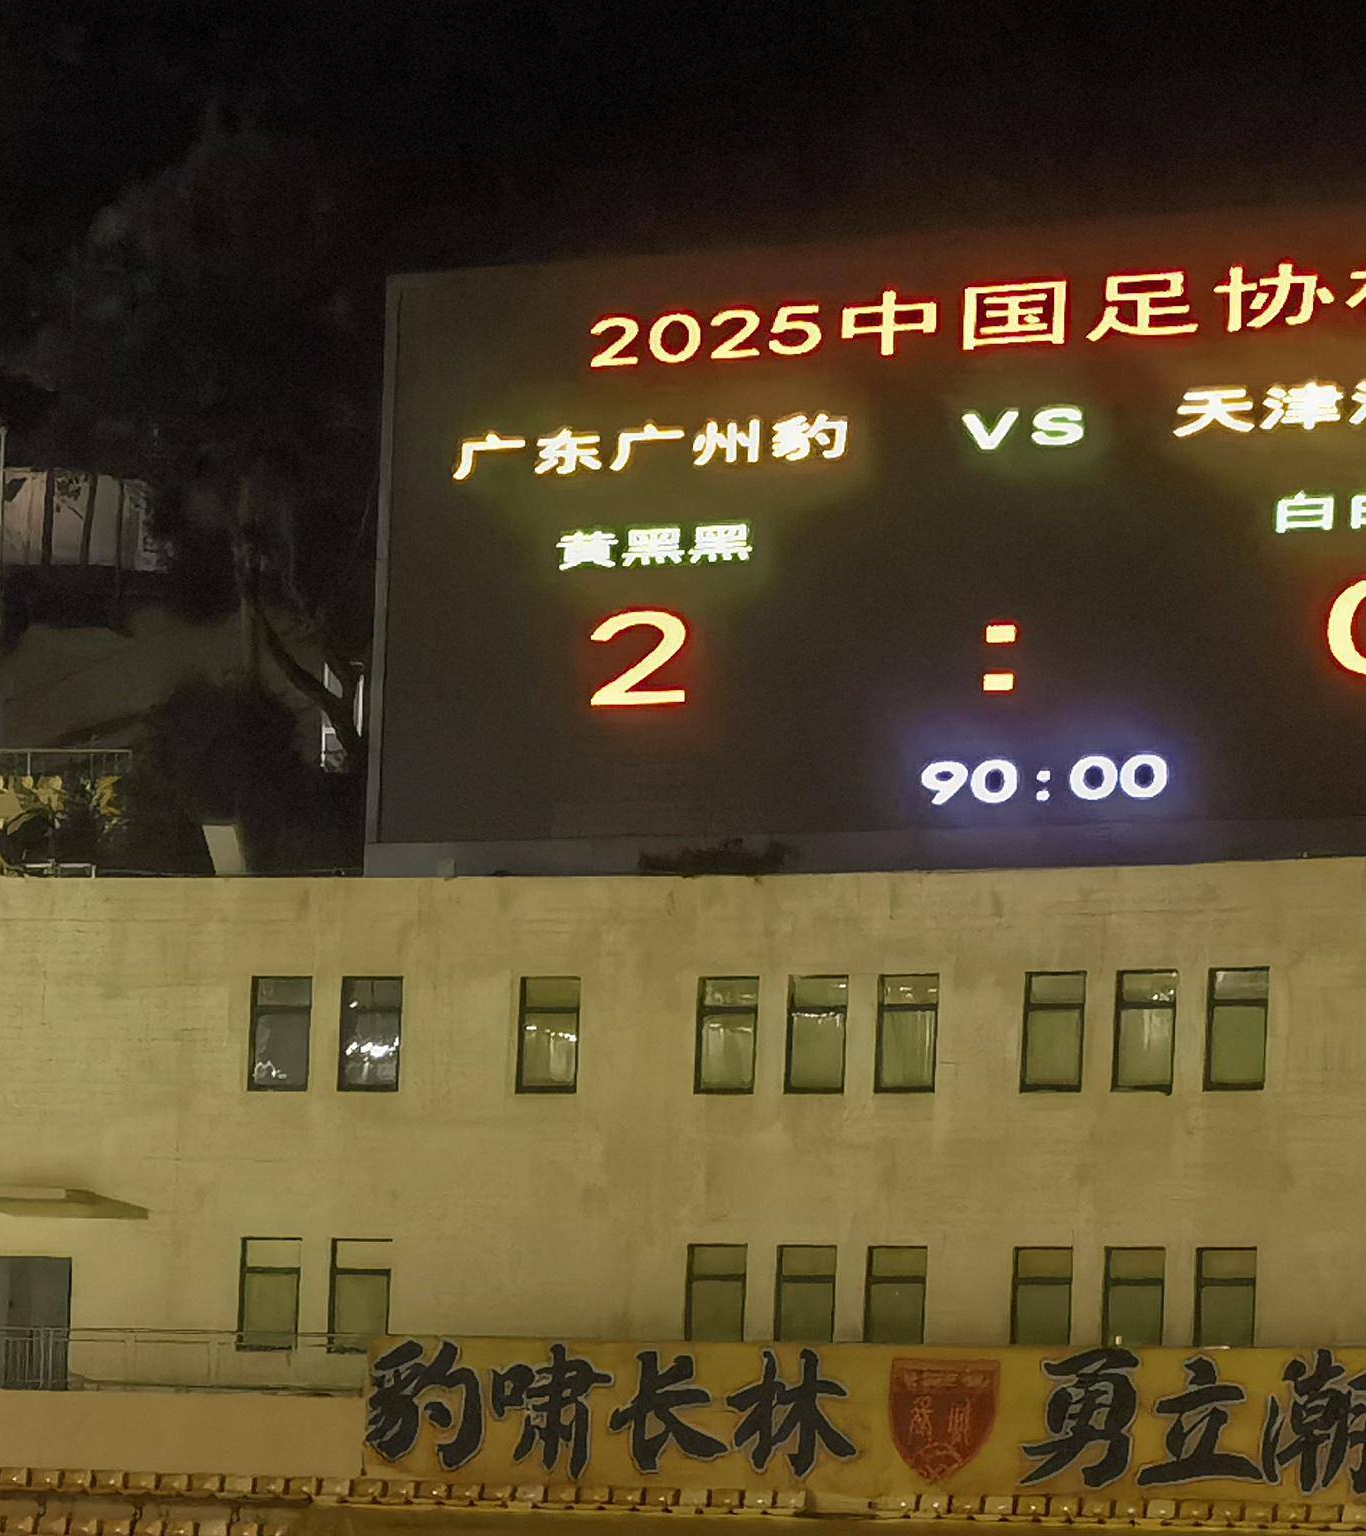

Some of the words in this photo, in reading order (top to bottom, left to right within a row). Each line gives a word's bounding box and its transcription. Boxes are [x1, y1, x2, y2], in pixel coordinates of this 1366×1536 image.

[451, 411, 849, 481] 广东广州豹
[960, 406, 1085, 451] VS
[555, 522, 753, 572] 黄黑黑
[589, 609, 687, 707] 2
[920, 752, 1170, 807] 90:00
